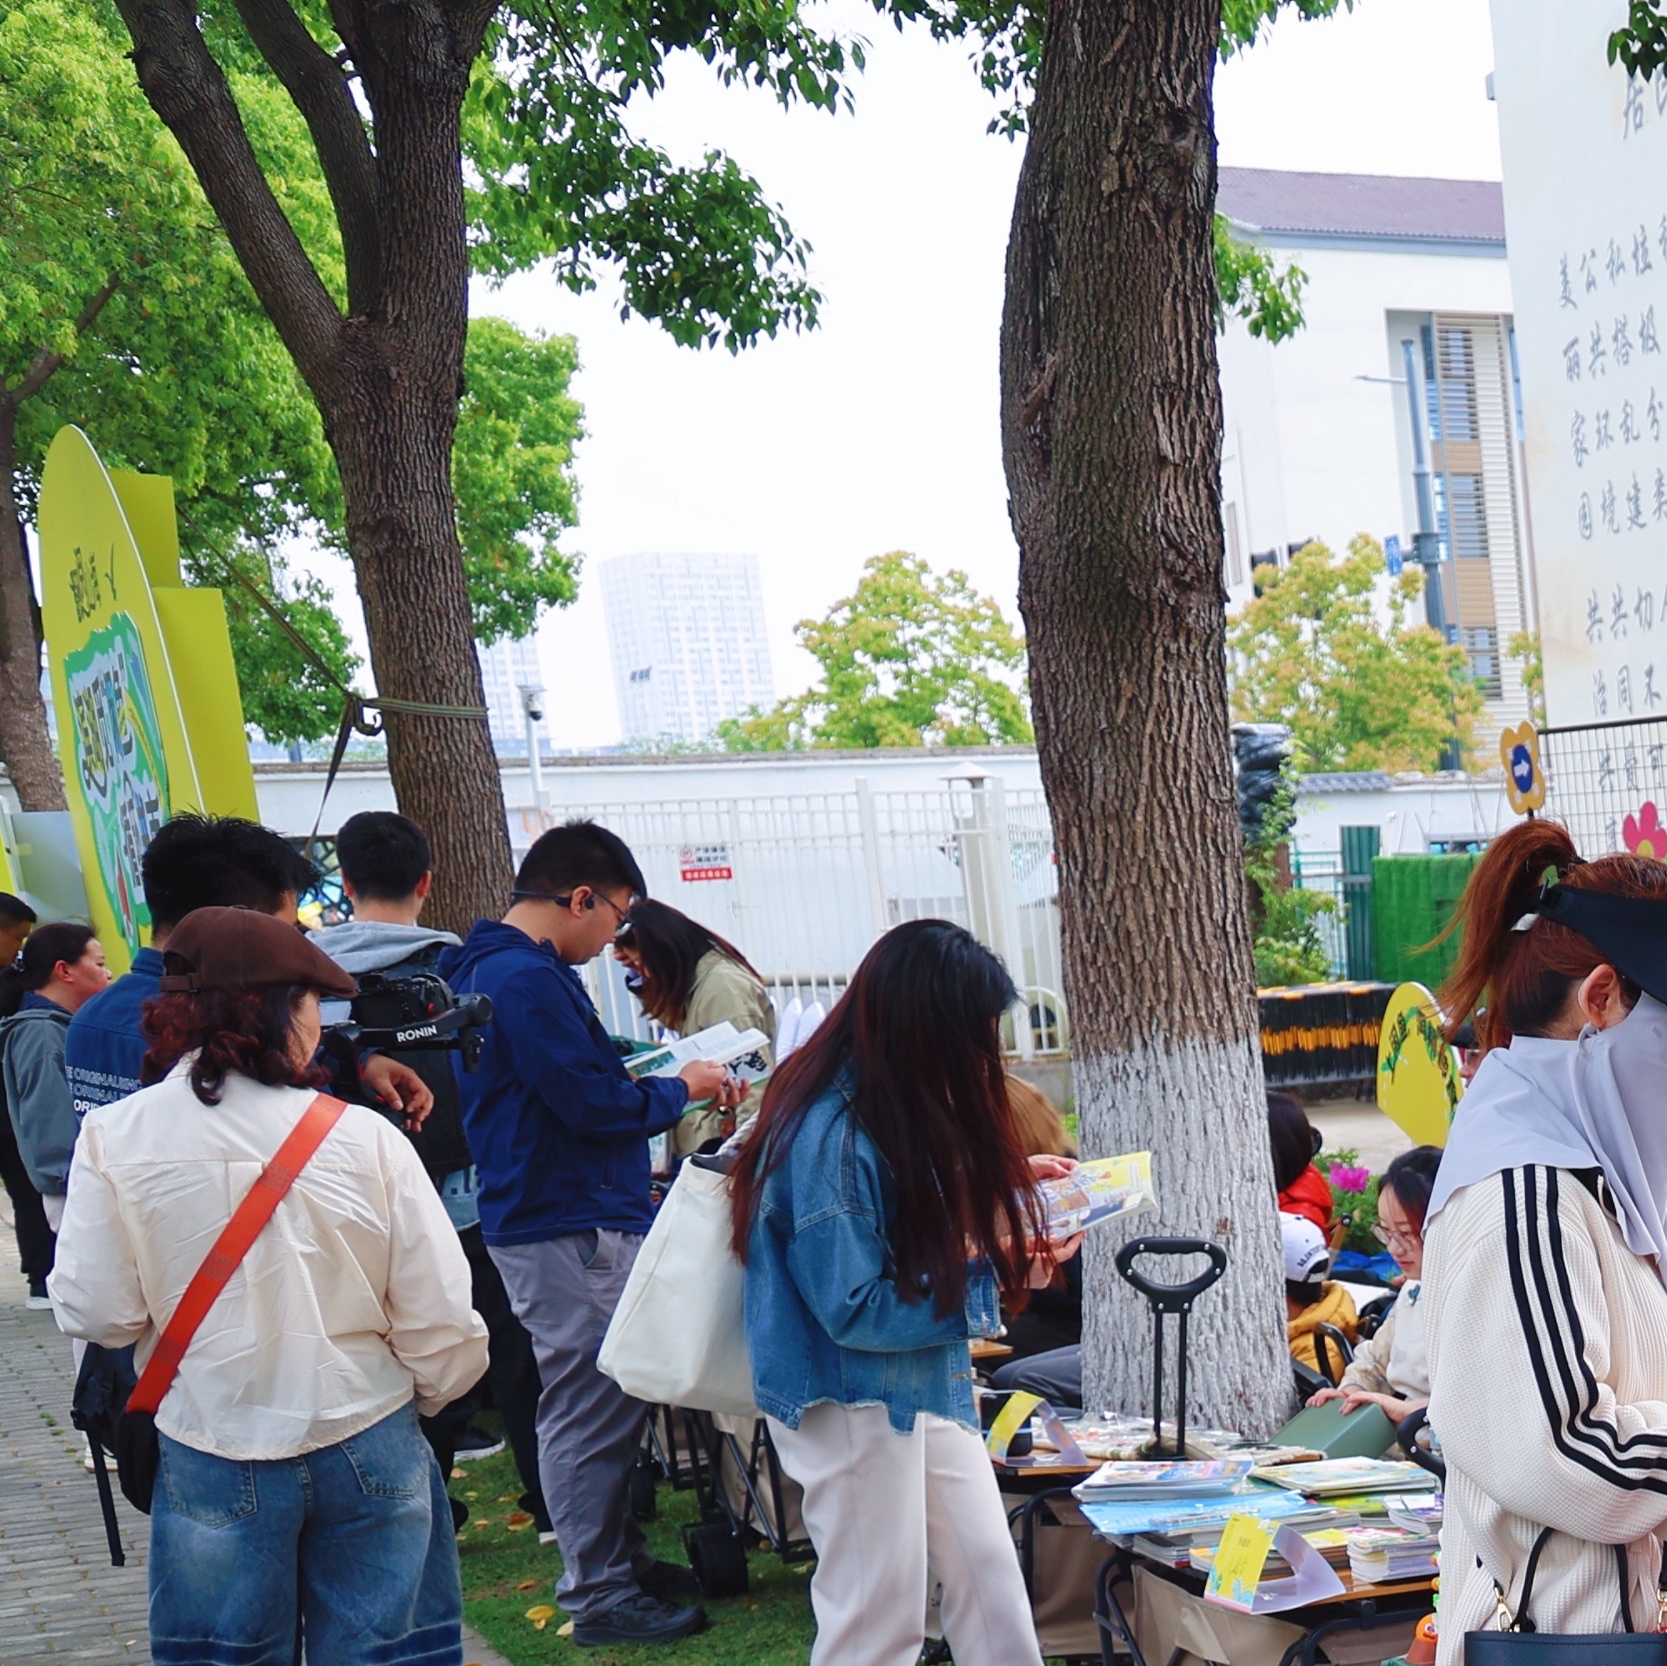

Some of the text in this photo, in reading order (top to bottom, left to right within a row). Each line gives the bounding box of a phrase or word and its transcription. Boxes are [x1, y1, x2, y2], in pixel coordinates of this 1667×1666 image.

[1578, 247, 1621, 536] 公共环境
[1605, 236, 1648, 532] 私搭乱建
